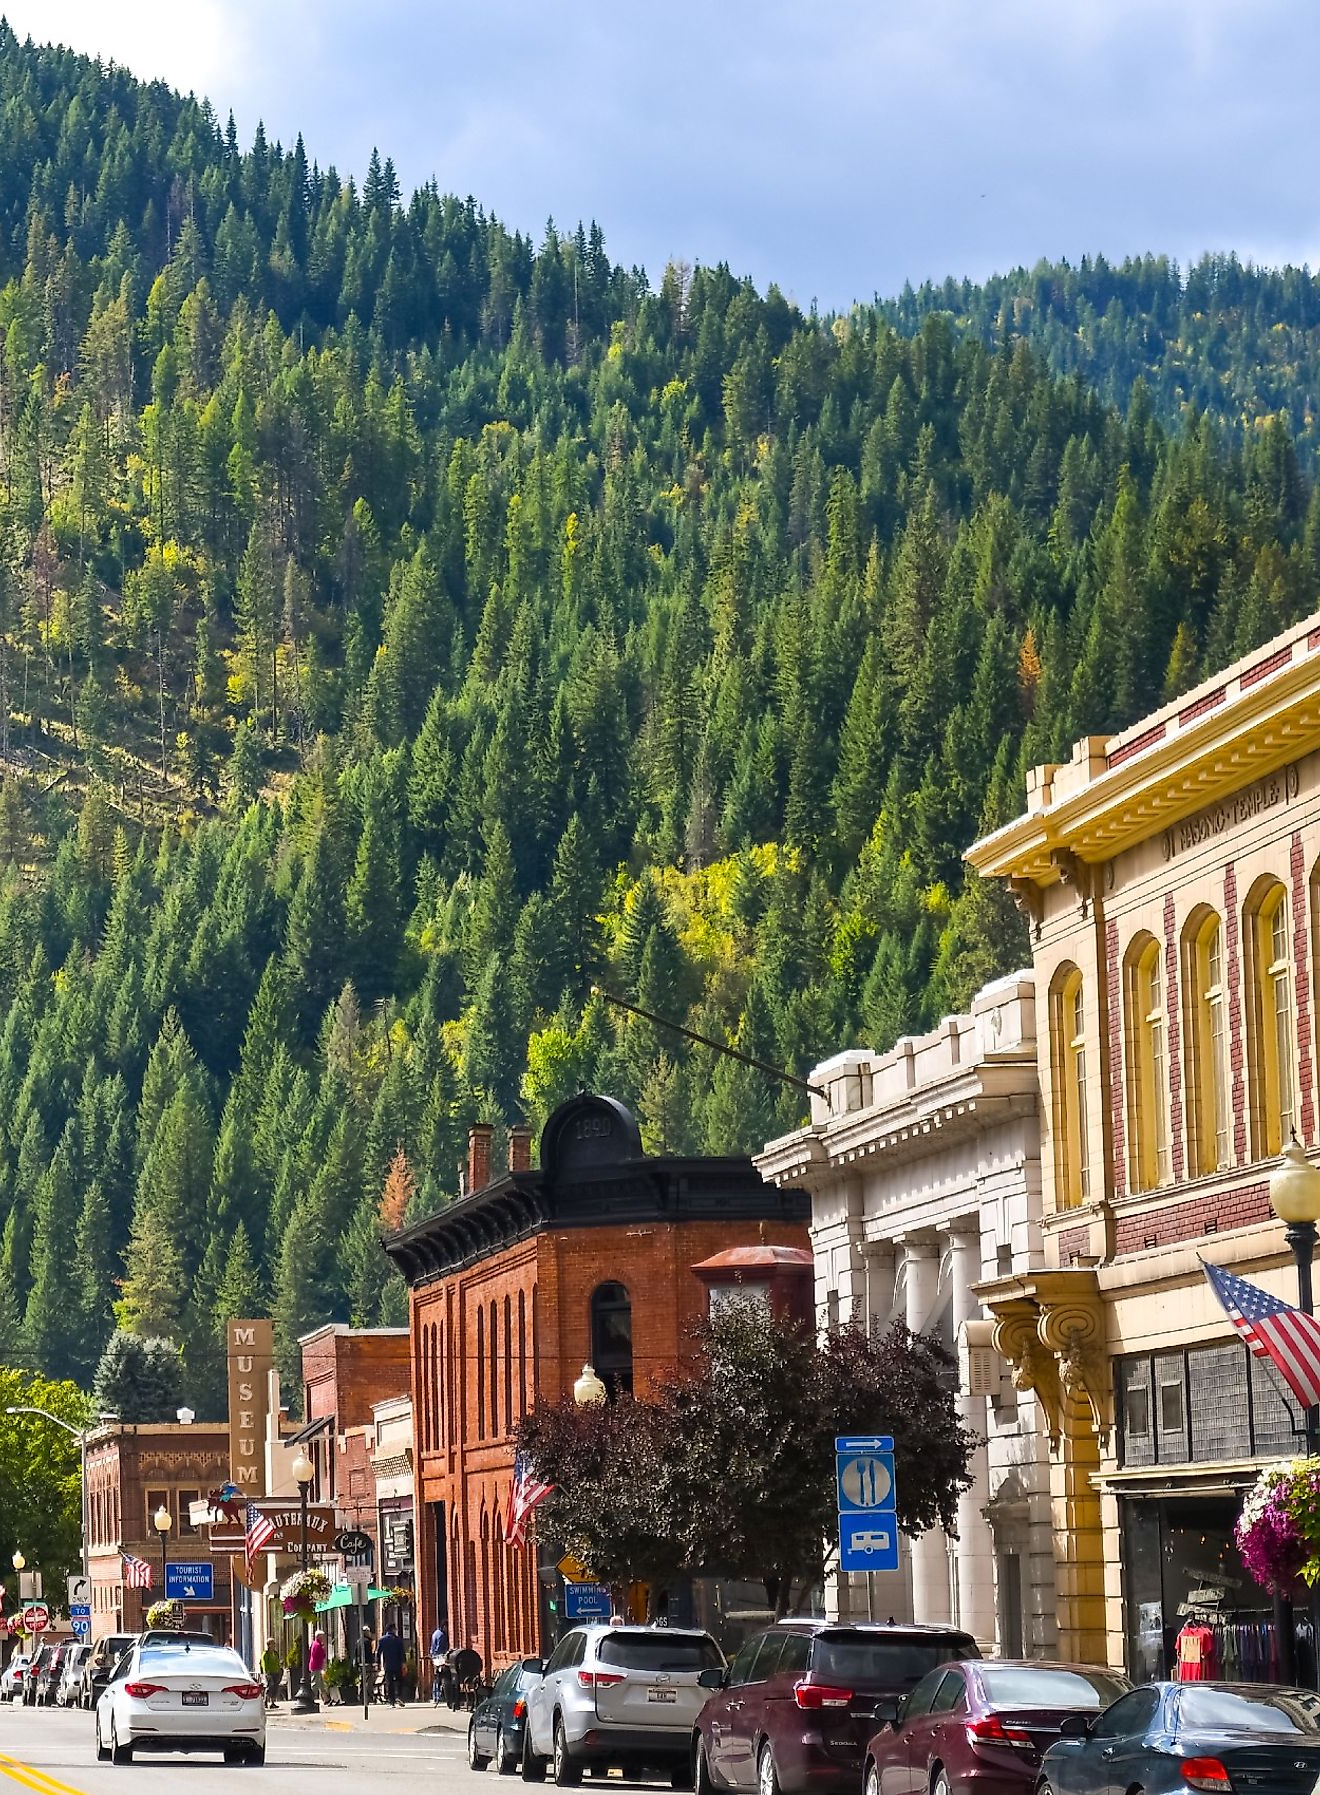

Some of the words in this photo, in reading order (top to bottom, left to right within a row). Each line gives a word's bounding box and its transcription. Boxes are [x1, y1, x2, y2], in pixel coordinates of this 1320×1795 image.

[1180, 806, 1226, 851] MASONIC
[1231, 781, 1278, 824] TEMPLE
[576, 1118, 612, 1139] 1890
[234, 1327, 258, 1484] MUSEUM
[175, 1566, 202, 1575] TOURIST
[168, 1575, 210, 1583] INFORMATION
[569, 1586, 607, 1595] SWIMMIN
[578, 1596, 598, 1605] POOL
[72, 1621, 89, 1632] 90
